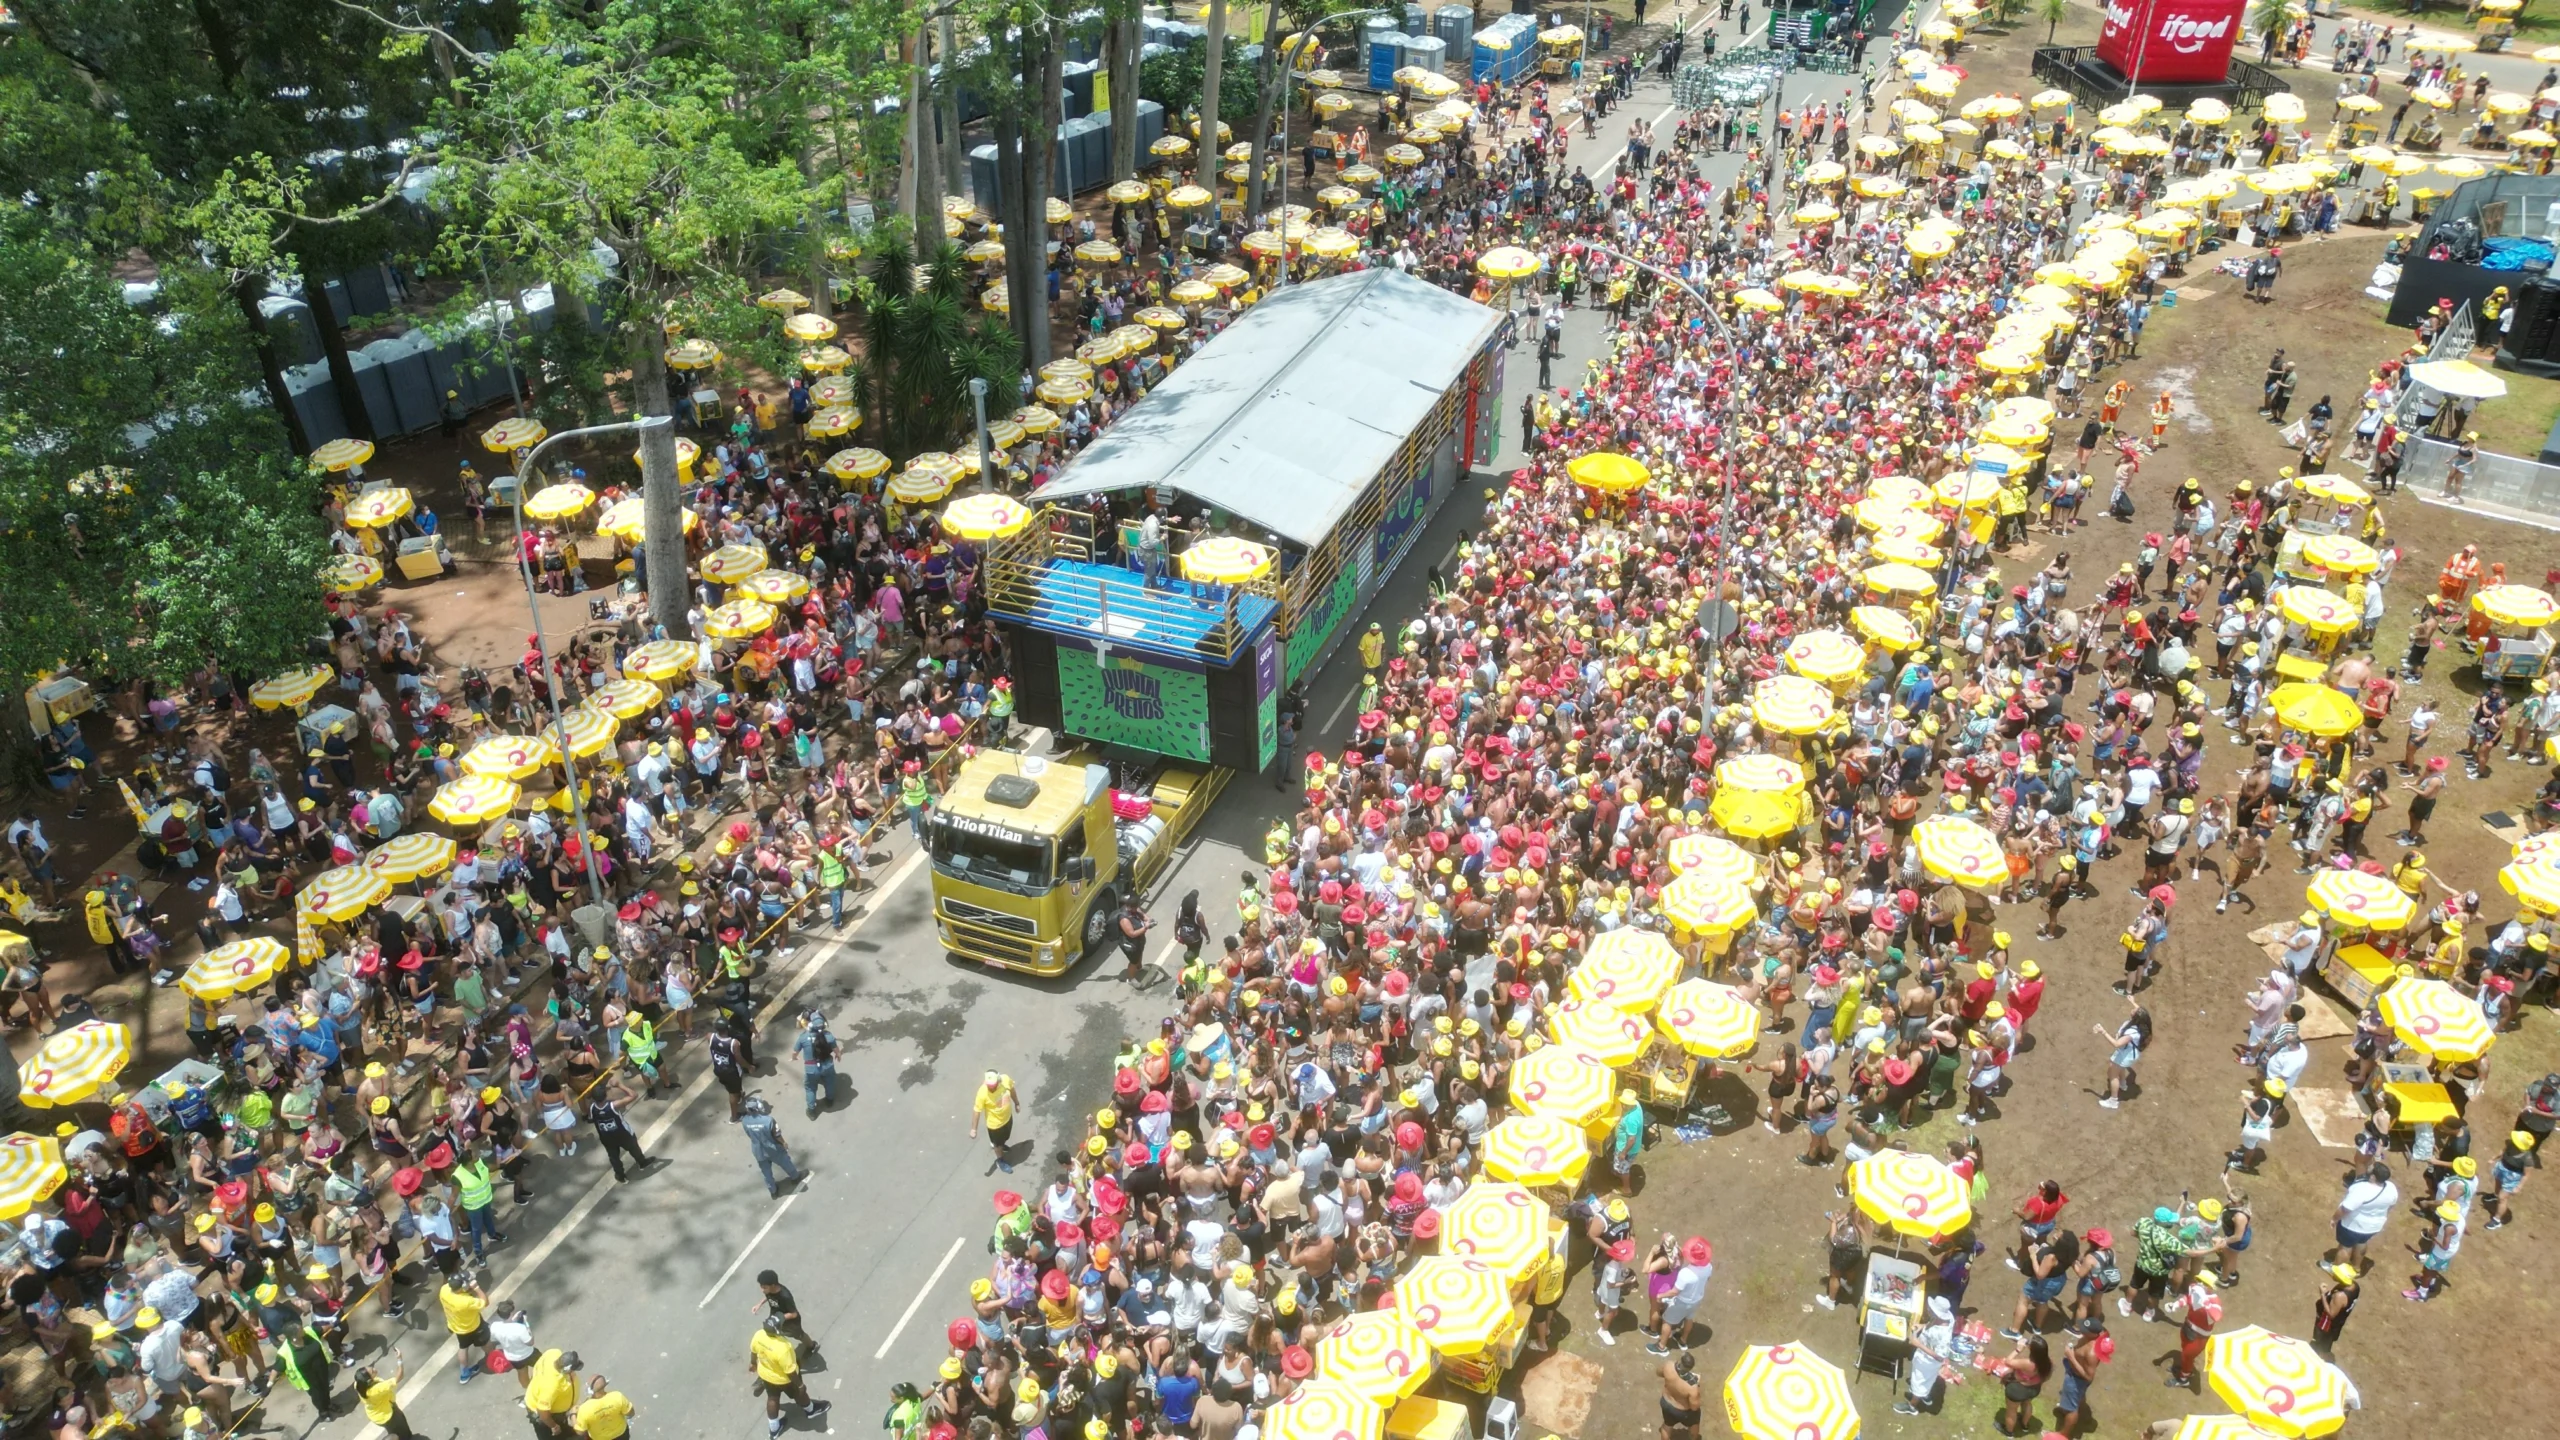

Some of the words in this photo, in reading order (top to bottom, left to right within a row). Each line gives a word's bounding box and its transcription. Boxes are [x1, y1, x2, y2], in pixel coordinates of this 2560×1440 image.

[2160, 14, 2232, 41] ifood
[952, 815, 977, 832] Trio
[988, 824, 1022, 844] Titan
[425, 862, 442, 876] SKOL
[2527, 896, 2548, 909] SKOL
[106, 1058, 124, 1077] SKOL
[42, 1177, 61, 1197] SKOL
[1525, 1257, 1542, 1276] SKOL
[1492, 1320, 1507, 1339] SKOL
[1725, 1397, 1739, 1424] SKOL
